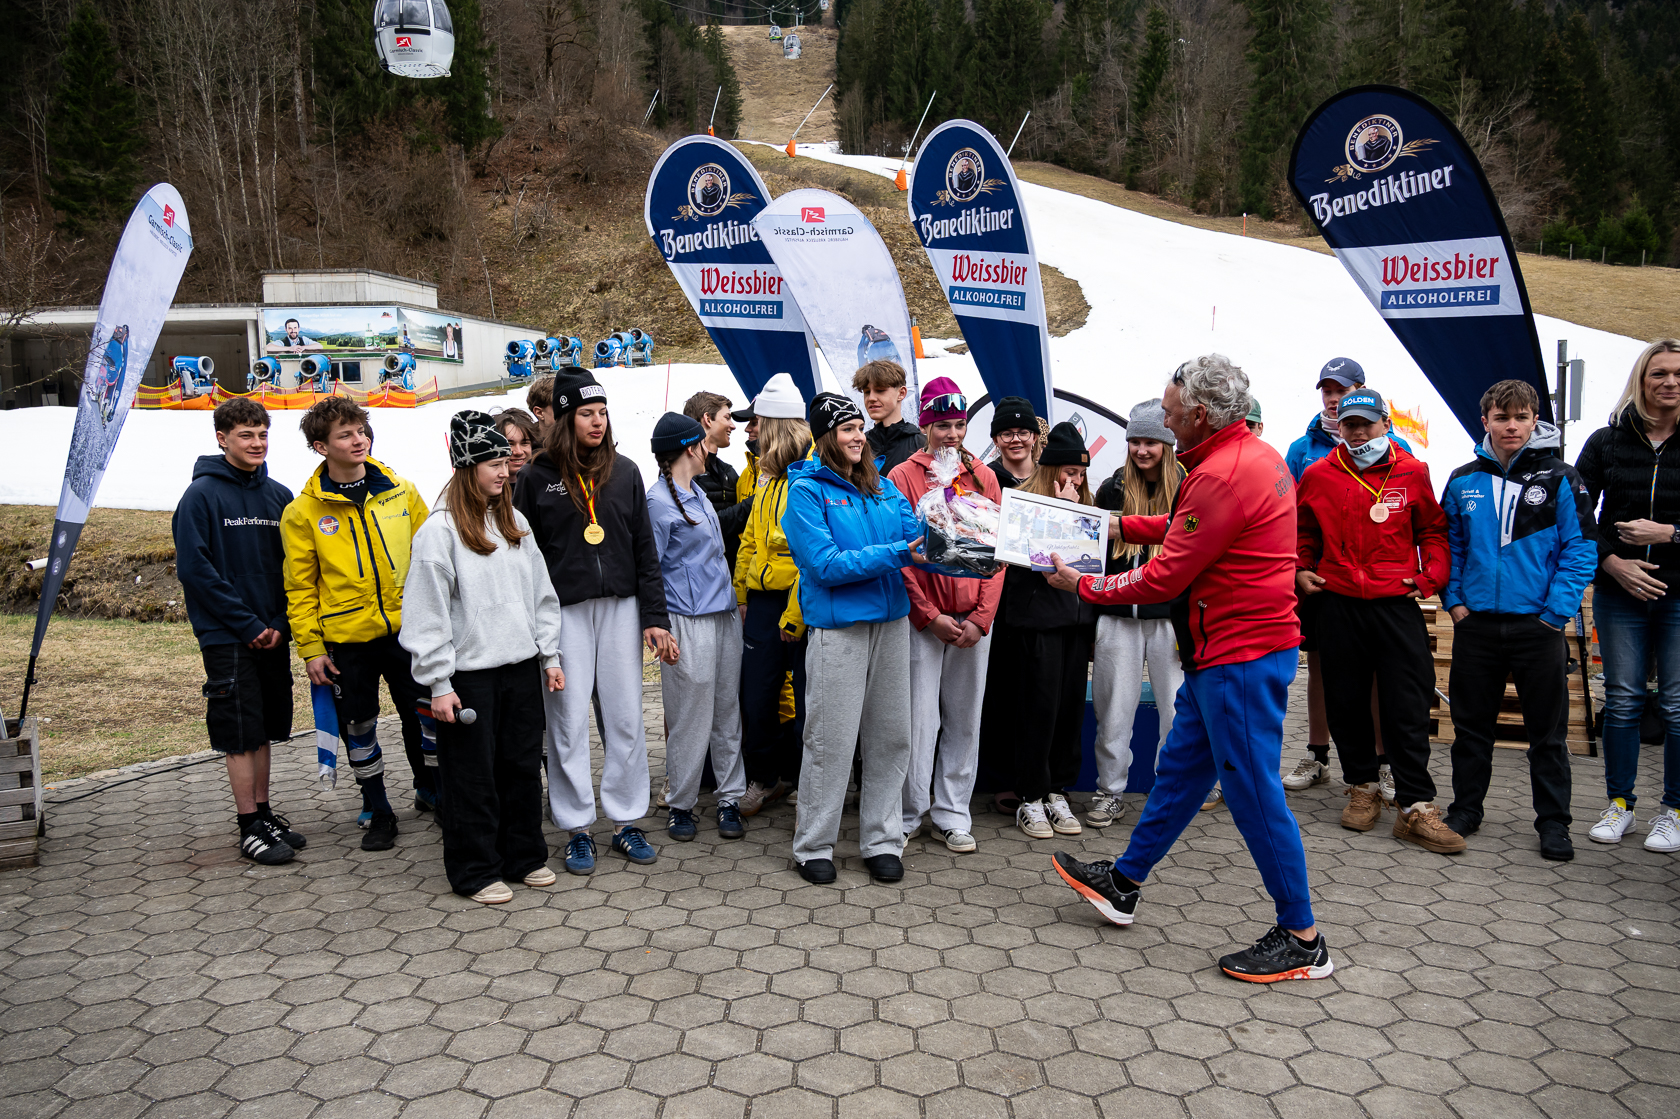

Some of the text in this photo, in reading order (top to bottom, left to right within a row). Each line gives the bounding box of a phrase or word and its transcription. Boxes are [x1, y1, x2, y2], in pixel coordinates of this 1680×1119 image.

[1350, 118, 1398, 151] BENEDIKTINER
[948, 150, 982, 178] BENEDIKTINER
[690, 166, 728, 193] BENEDIKTINER
[1308, 164, 1454, 228] Benediktiner
[660, 220, 762, 261] Benediktine
[918, 206, 1015, 247] Benediktiner
[700, 267, 784, 296] Weissbier
[952, 254, 1028, 286] Weissbier
[1380, 252, 1500, 286] Weissbier
[704, 302, 777, 315] ALKOHOLFREI
[952, 290, 1022, 306] ALKOHOLFREI
[1388, 290, 1491, 305] ALKOHOLFREI
[1343, 396, 1374, 406] SÖLDEN
